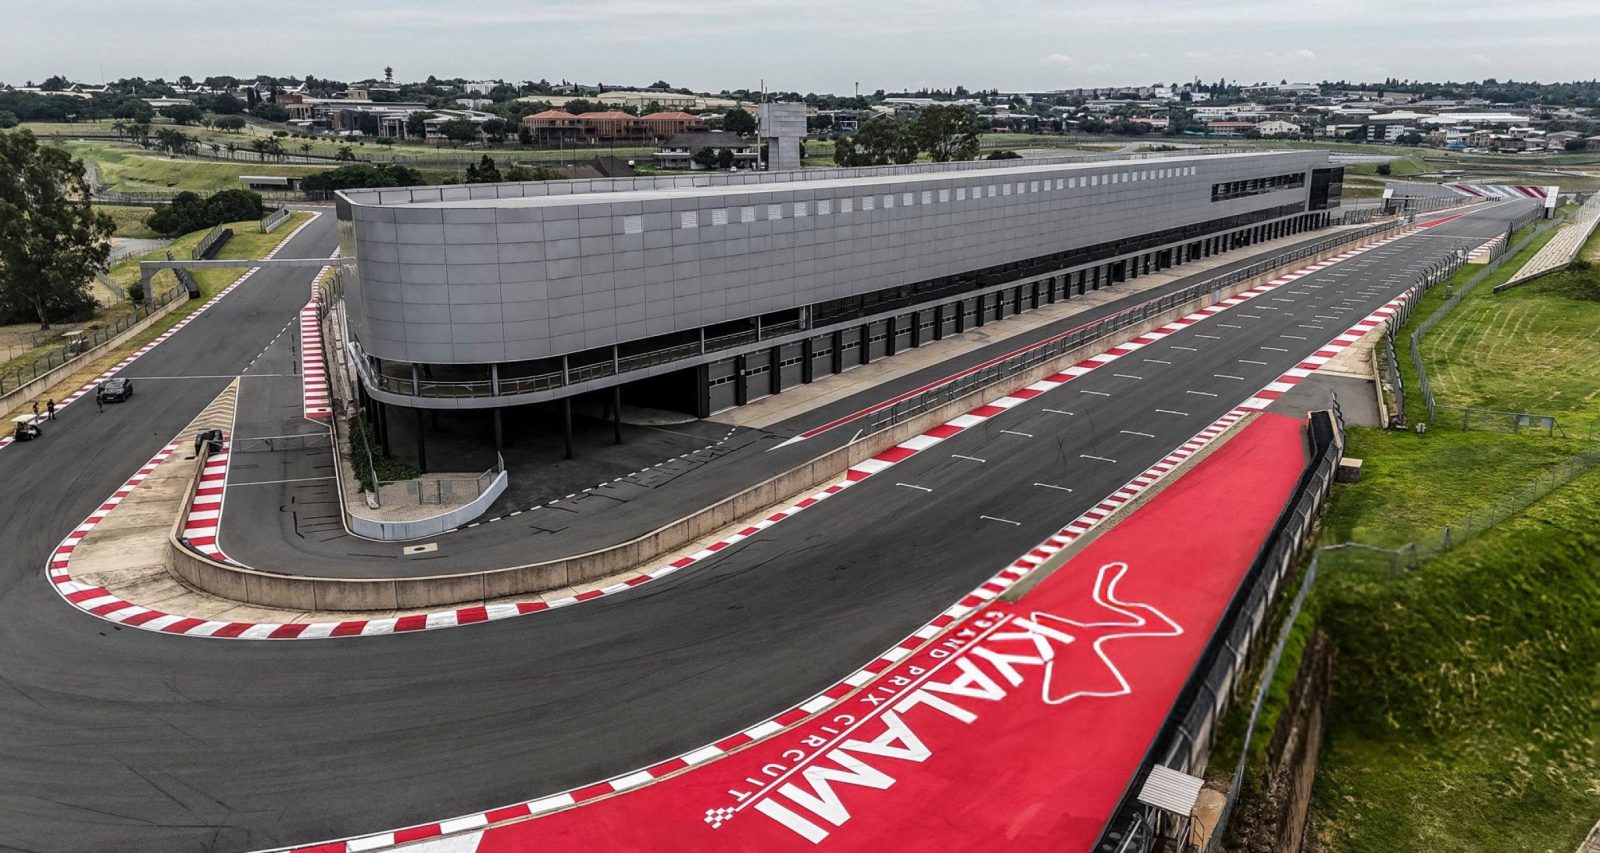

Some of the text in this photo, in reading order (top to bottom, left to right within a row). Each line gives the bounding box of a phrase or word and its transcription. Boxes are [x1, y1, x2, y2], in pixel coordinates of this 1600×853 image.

[728, 611, 1005, 802] GRAND PRIX CIRCUIT
[753, 617, 1076, 844] KYALAMI
